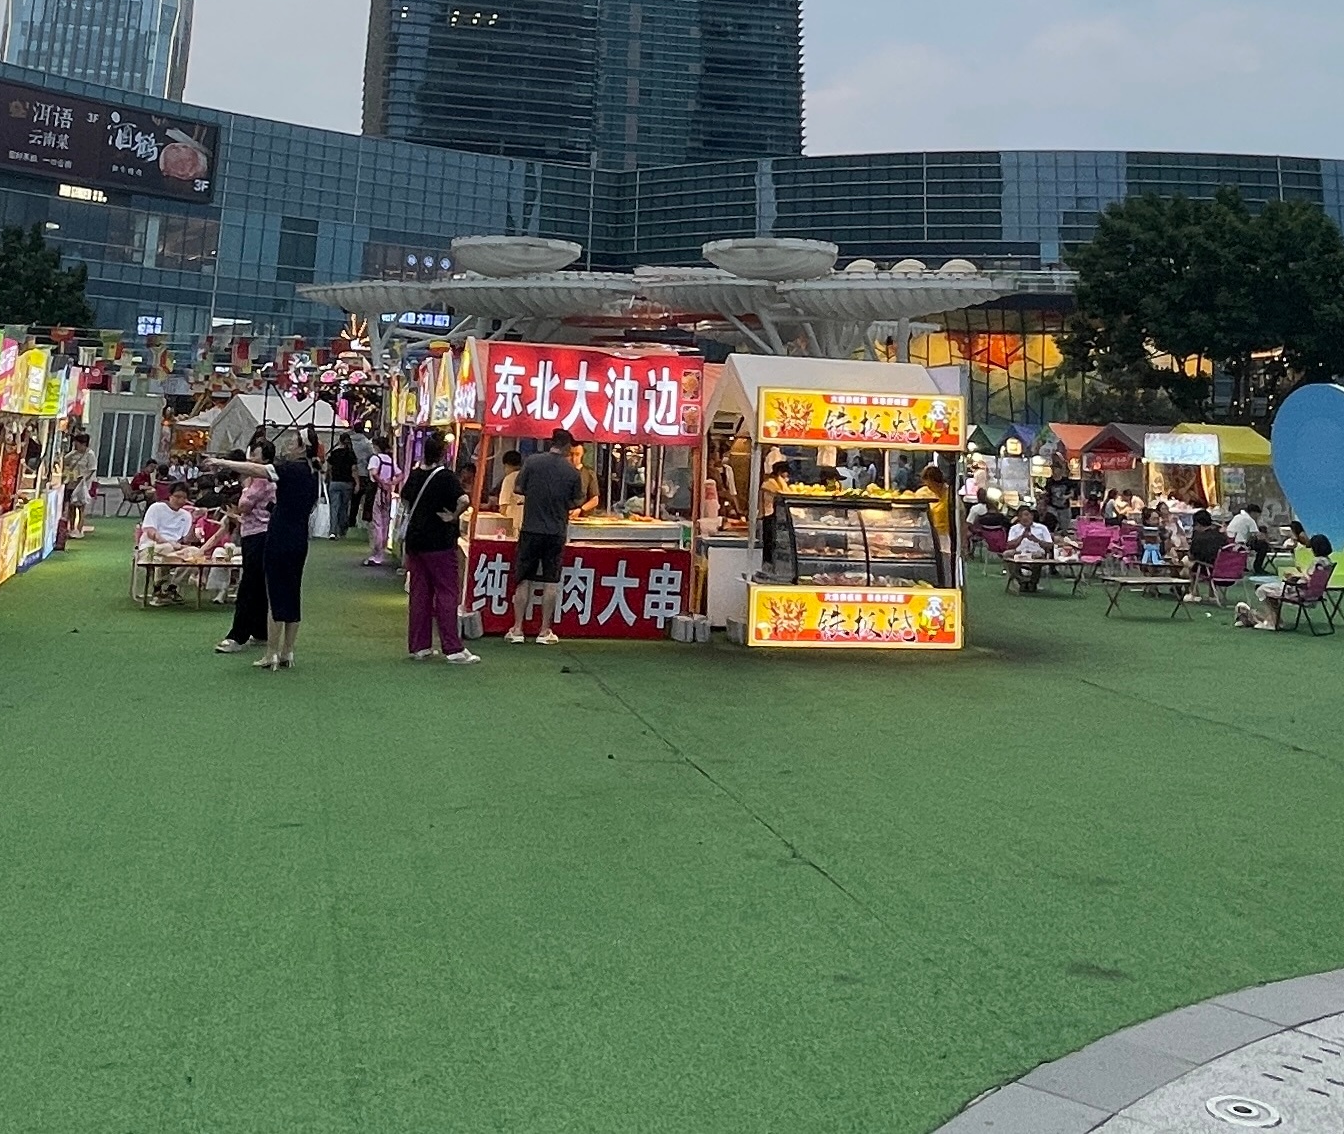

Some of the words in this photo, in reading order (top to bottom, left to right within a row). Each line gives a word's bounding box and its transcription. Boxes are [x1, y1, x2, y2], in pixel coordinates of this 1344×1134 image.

[86, 112, 100, 124] 3F
[28, 129, 70, 151] 云南菜
[193, 179, 210, 193] 3F
[490, 355, 680, 436] 东北大油边
[472, 553, 682, 628] 纯肉大串
